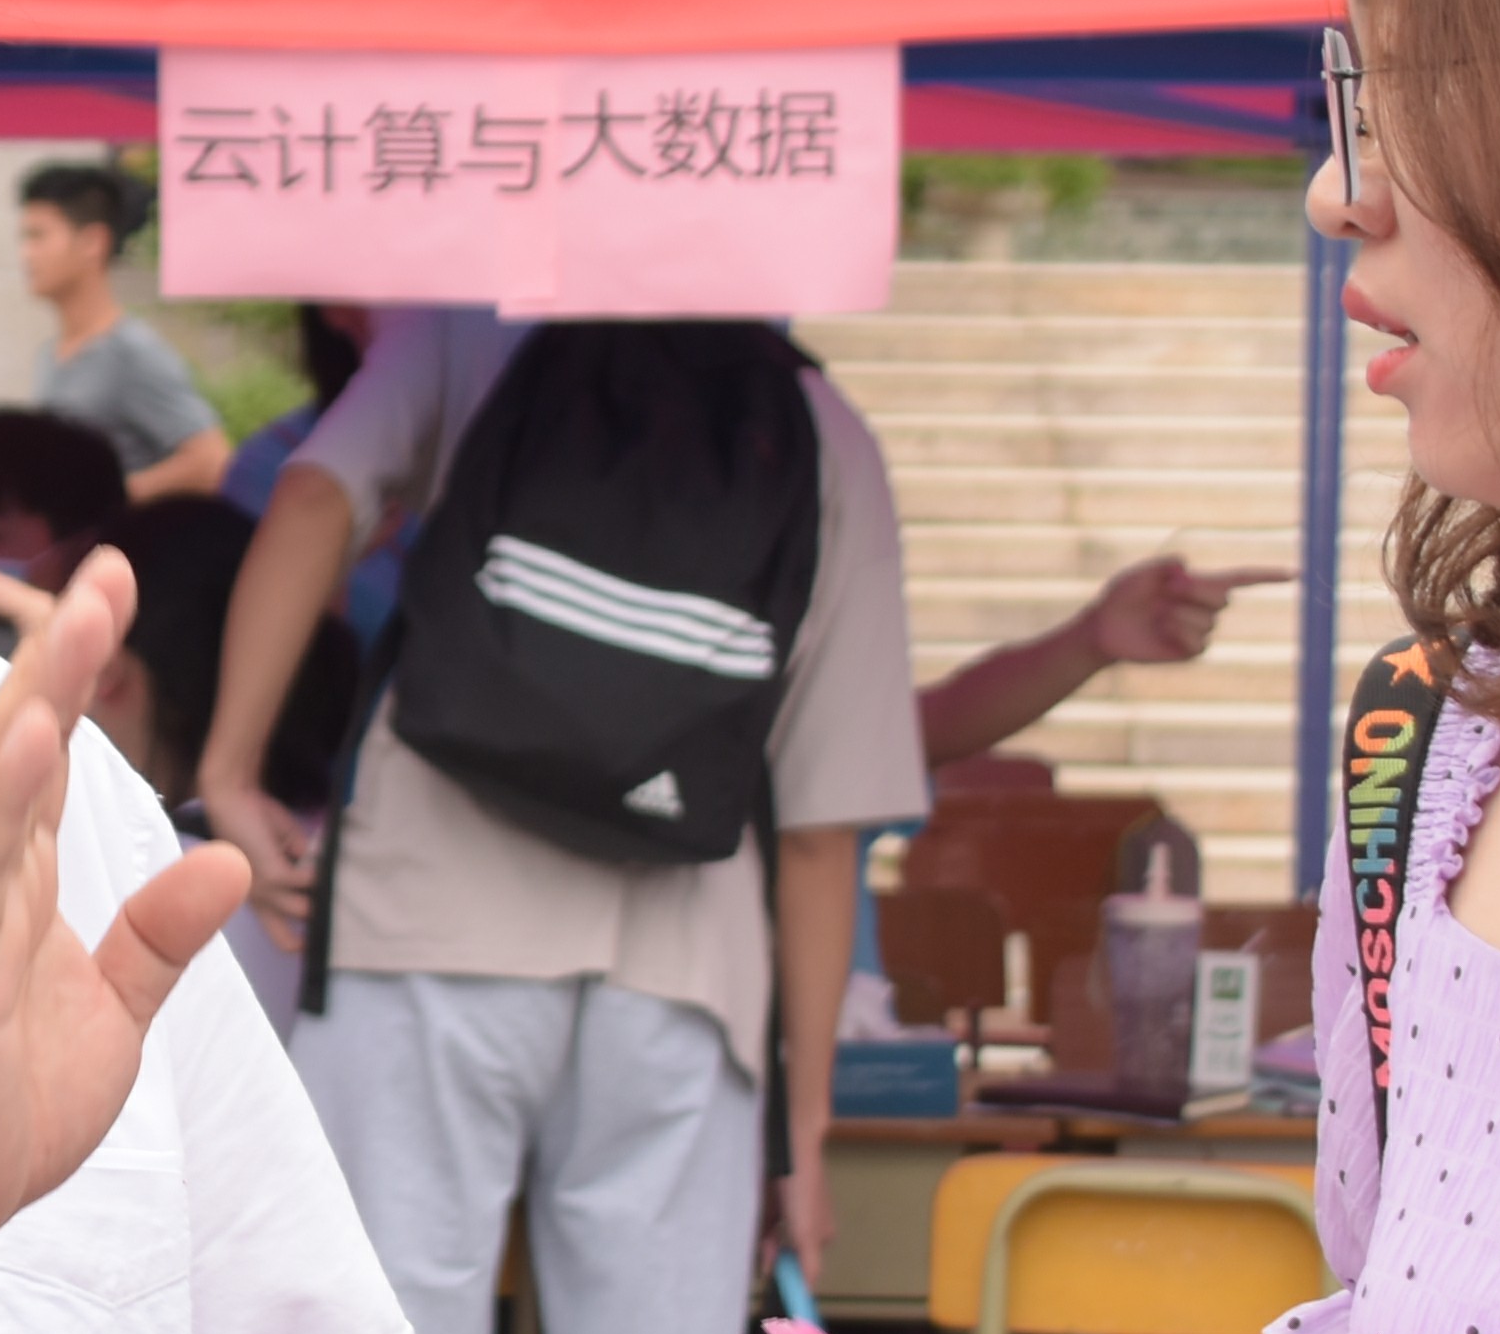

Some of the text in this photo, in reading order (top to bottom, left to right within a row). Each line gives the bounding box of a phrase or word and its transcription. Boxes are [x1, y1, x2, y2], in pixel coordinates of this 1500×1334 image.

[172, 87, 841, 197] 云计算与大数据
[1348, 709, 1416, 1089] MOSCHINO
